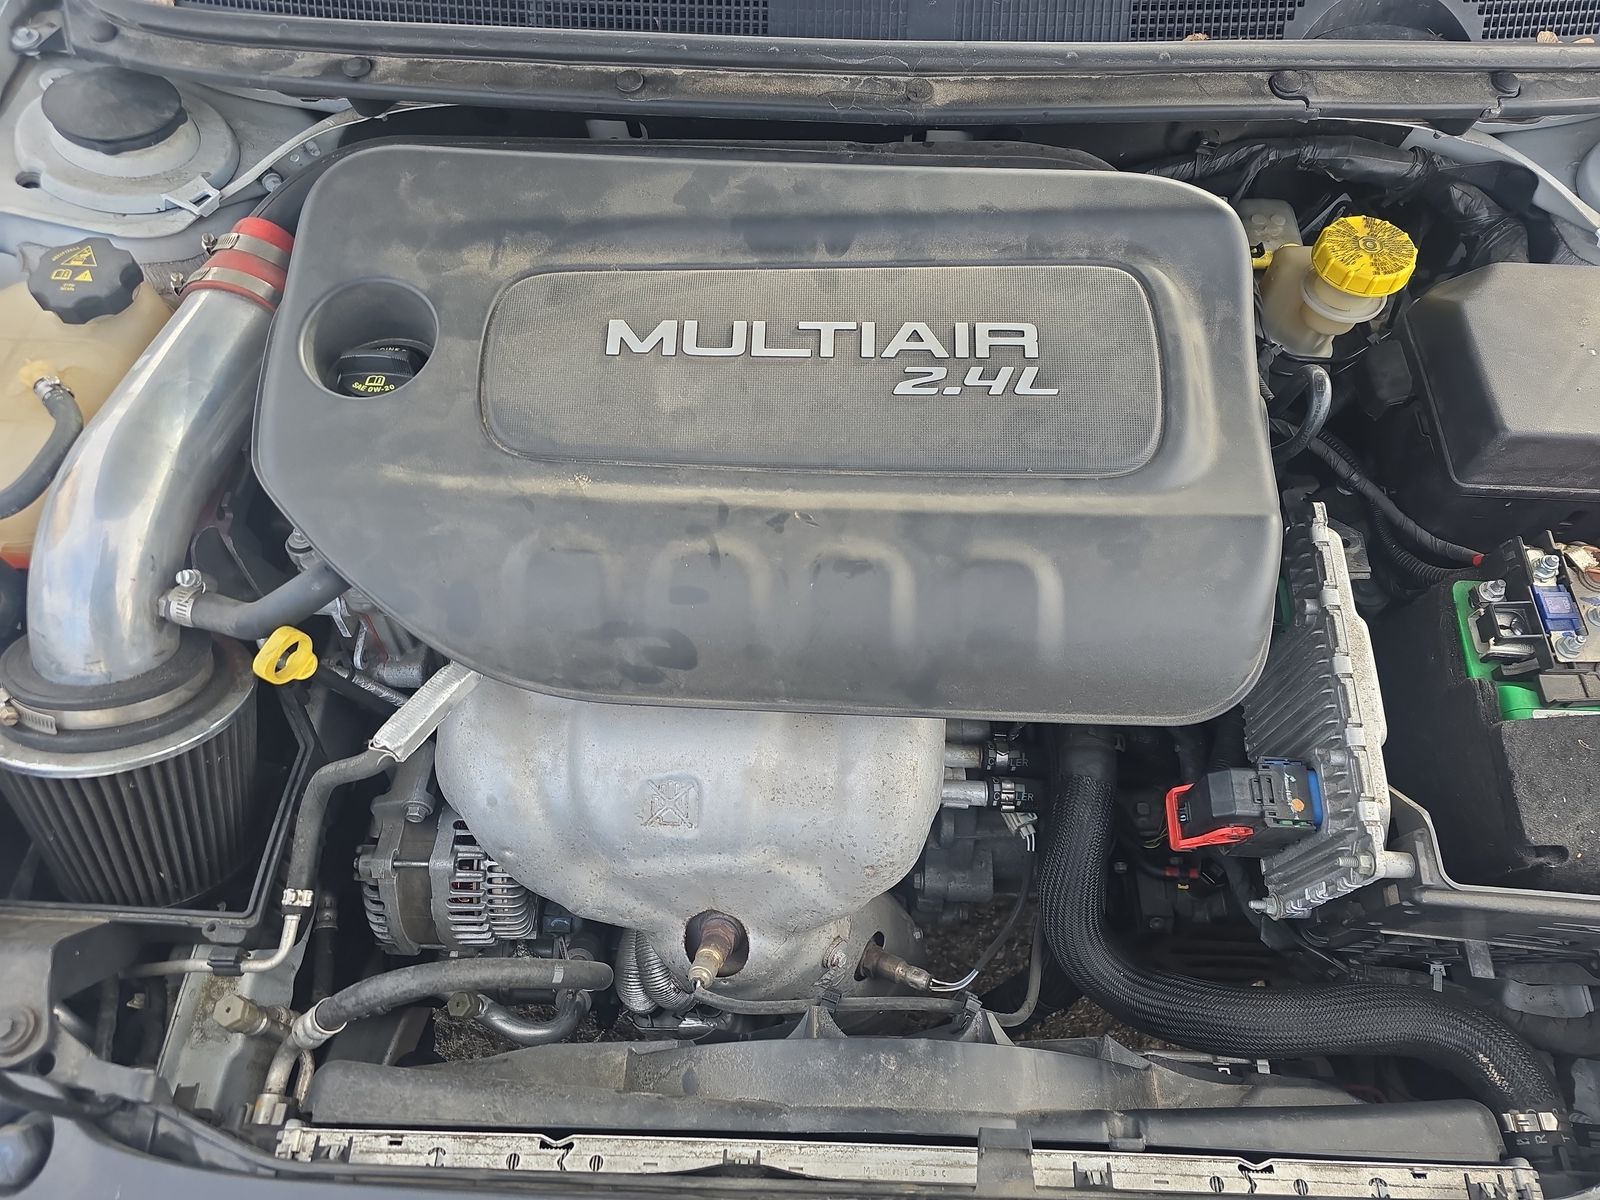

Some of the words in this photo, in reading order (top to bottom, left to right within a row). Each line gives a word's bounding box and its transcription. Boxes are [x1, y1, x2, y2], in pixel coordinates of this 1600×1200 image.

[605, 319, 1039, 358] MULTIAIR
[352, 382, 367, 392] SAE
[367, 384, 395, 393] 0W-20
[892, 366, 1060, 396] 2.4L
